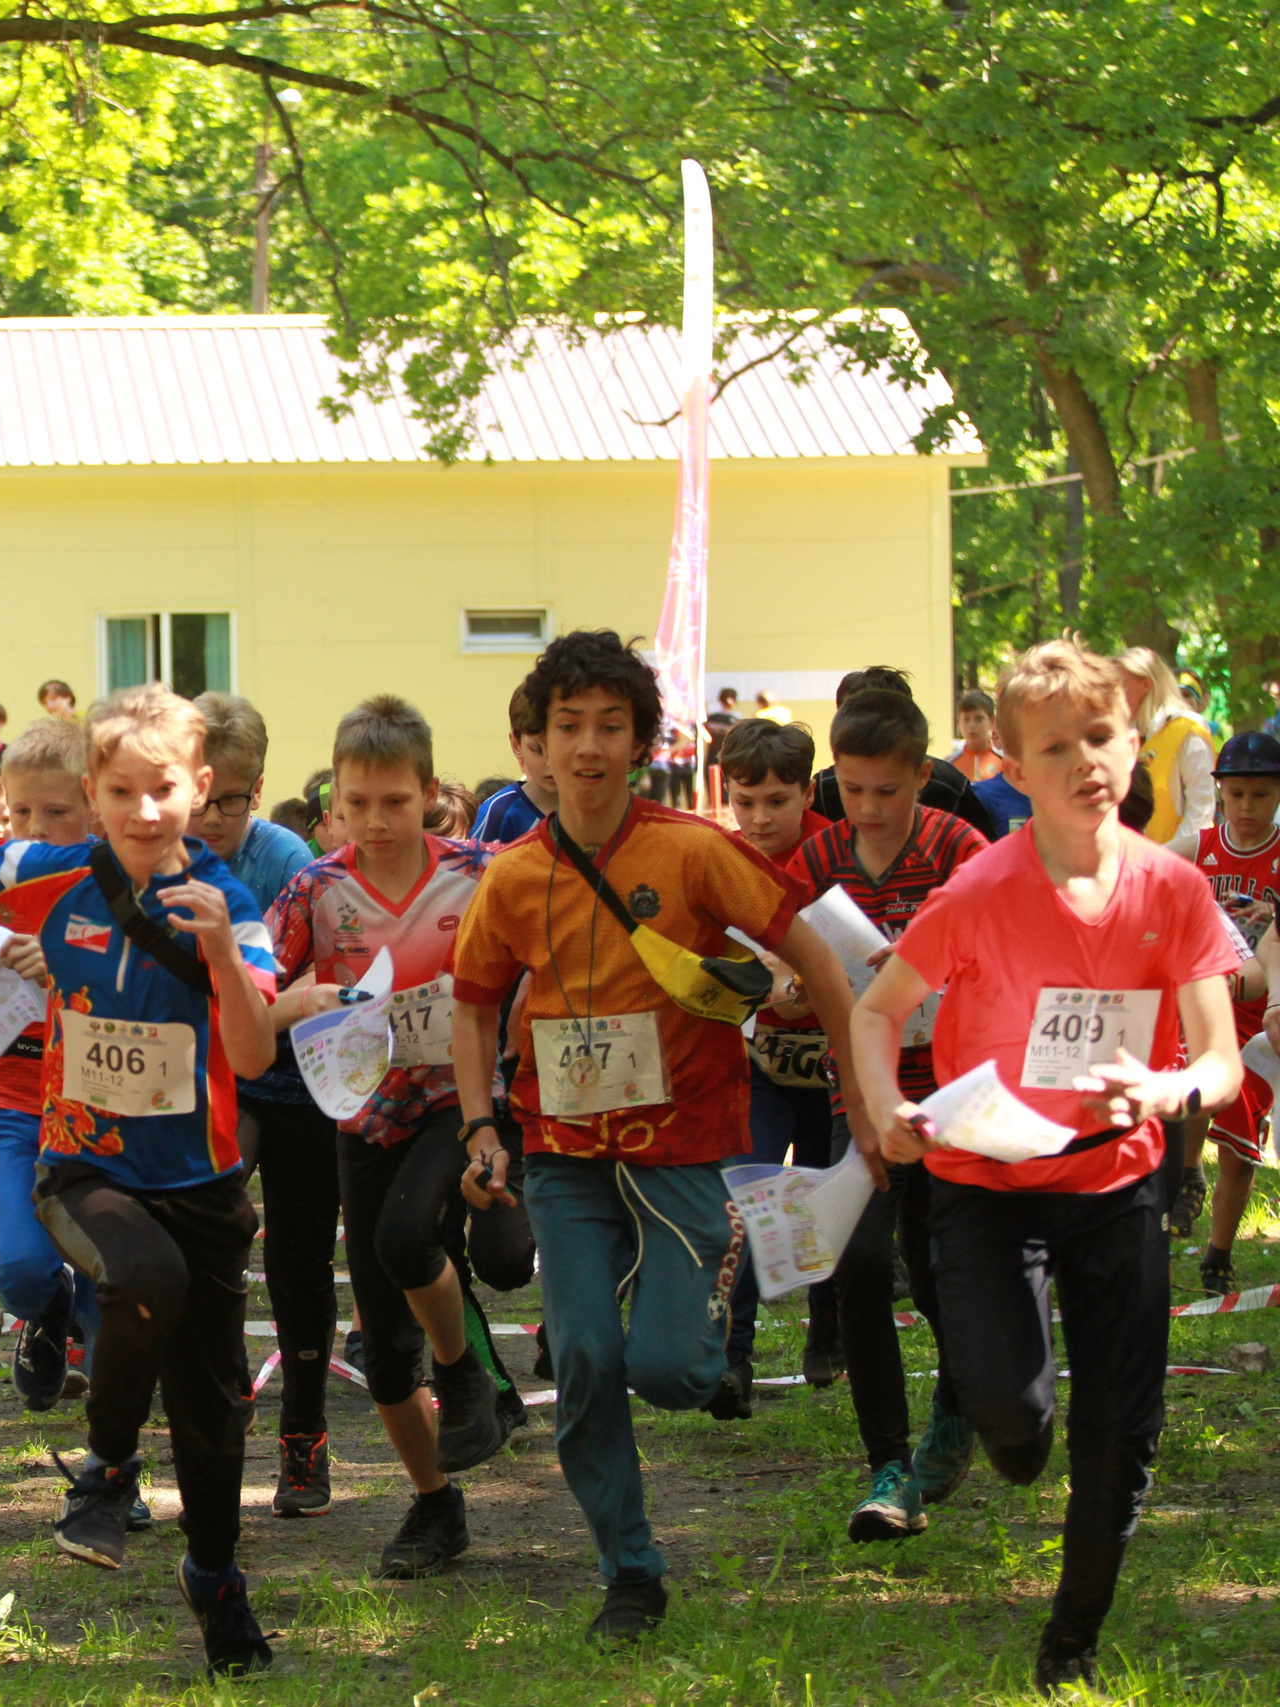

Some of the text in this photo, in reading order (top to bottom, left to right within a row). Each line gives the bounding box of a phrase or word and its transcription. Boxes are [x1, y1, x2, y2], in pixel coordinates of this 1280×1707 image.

[1040, 1014, 1125, 1046] 409 1
[86, 1042, 167, 1077] 406 1
[627, 1052, 636, 1068] 1
[1030, 1045, 1080, 1059] M11-12
[81, 1066, 124, 1087] M11-12
